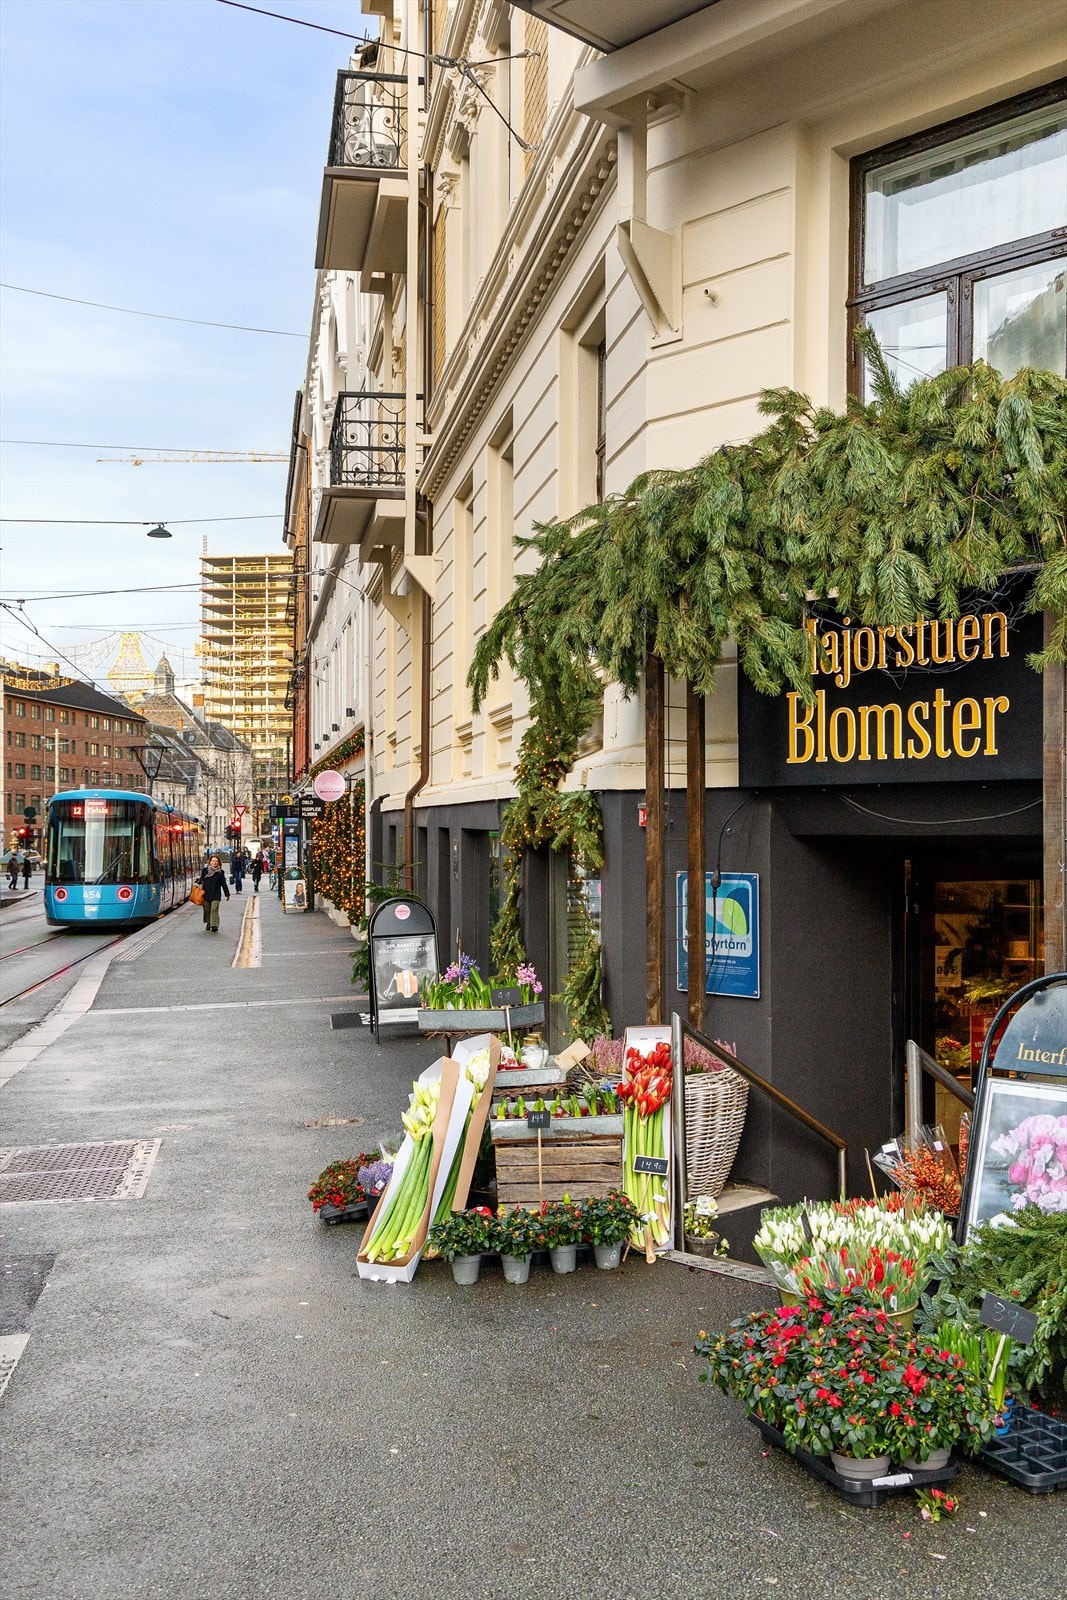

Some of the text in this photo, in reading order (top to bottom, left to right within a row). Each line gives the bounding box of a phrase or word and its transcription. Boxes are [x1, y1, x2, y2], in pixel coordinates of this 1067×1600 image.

[806, 611, 1010, 688] ajorstuen
[786, 688, 1010, 763] Blomster
[73, 807, 82, 815] 12
[83, 891, 101, 899] 454
[1016, 1042, 1067, 1066] Interf
